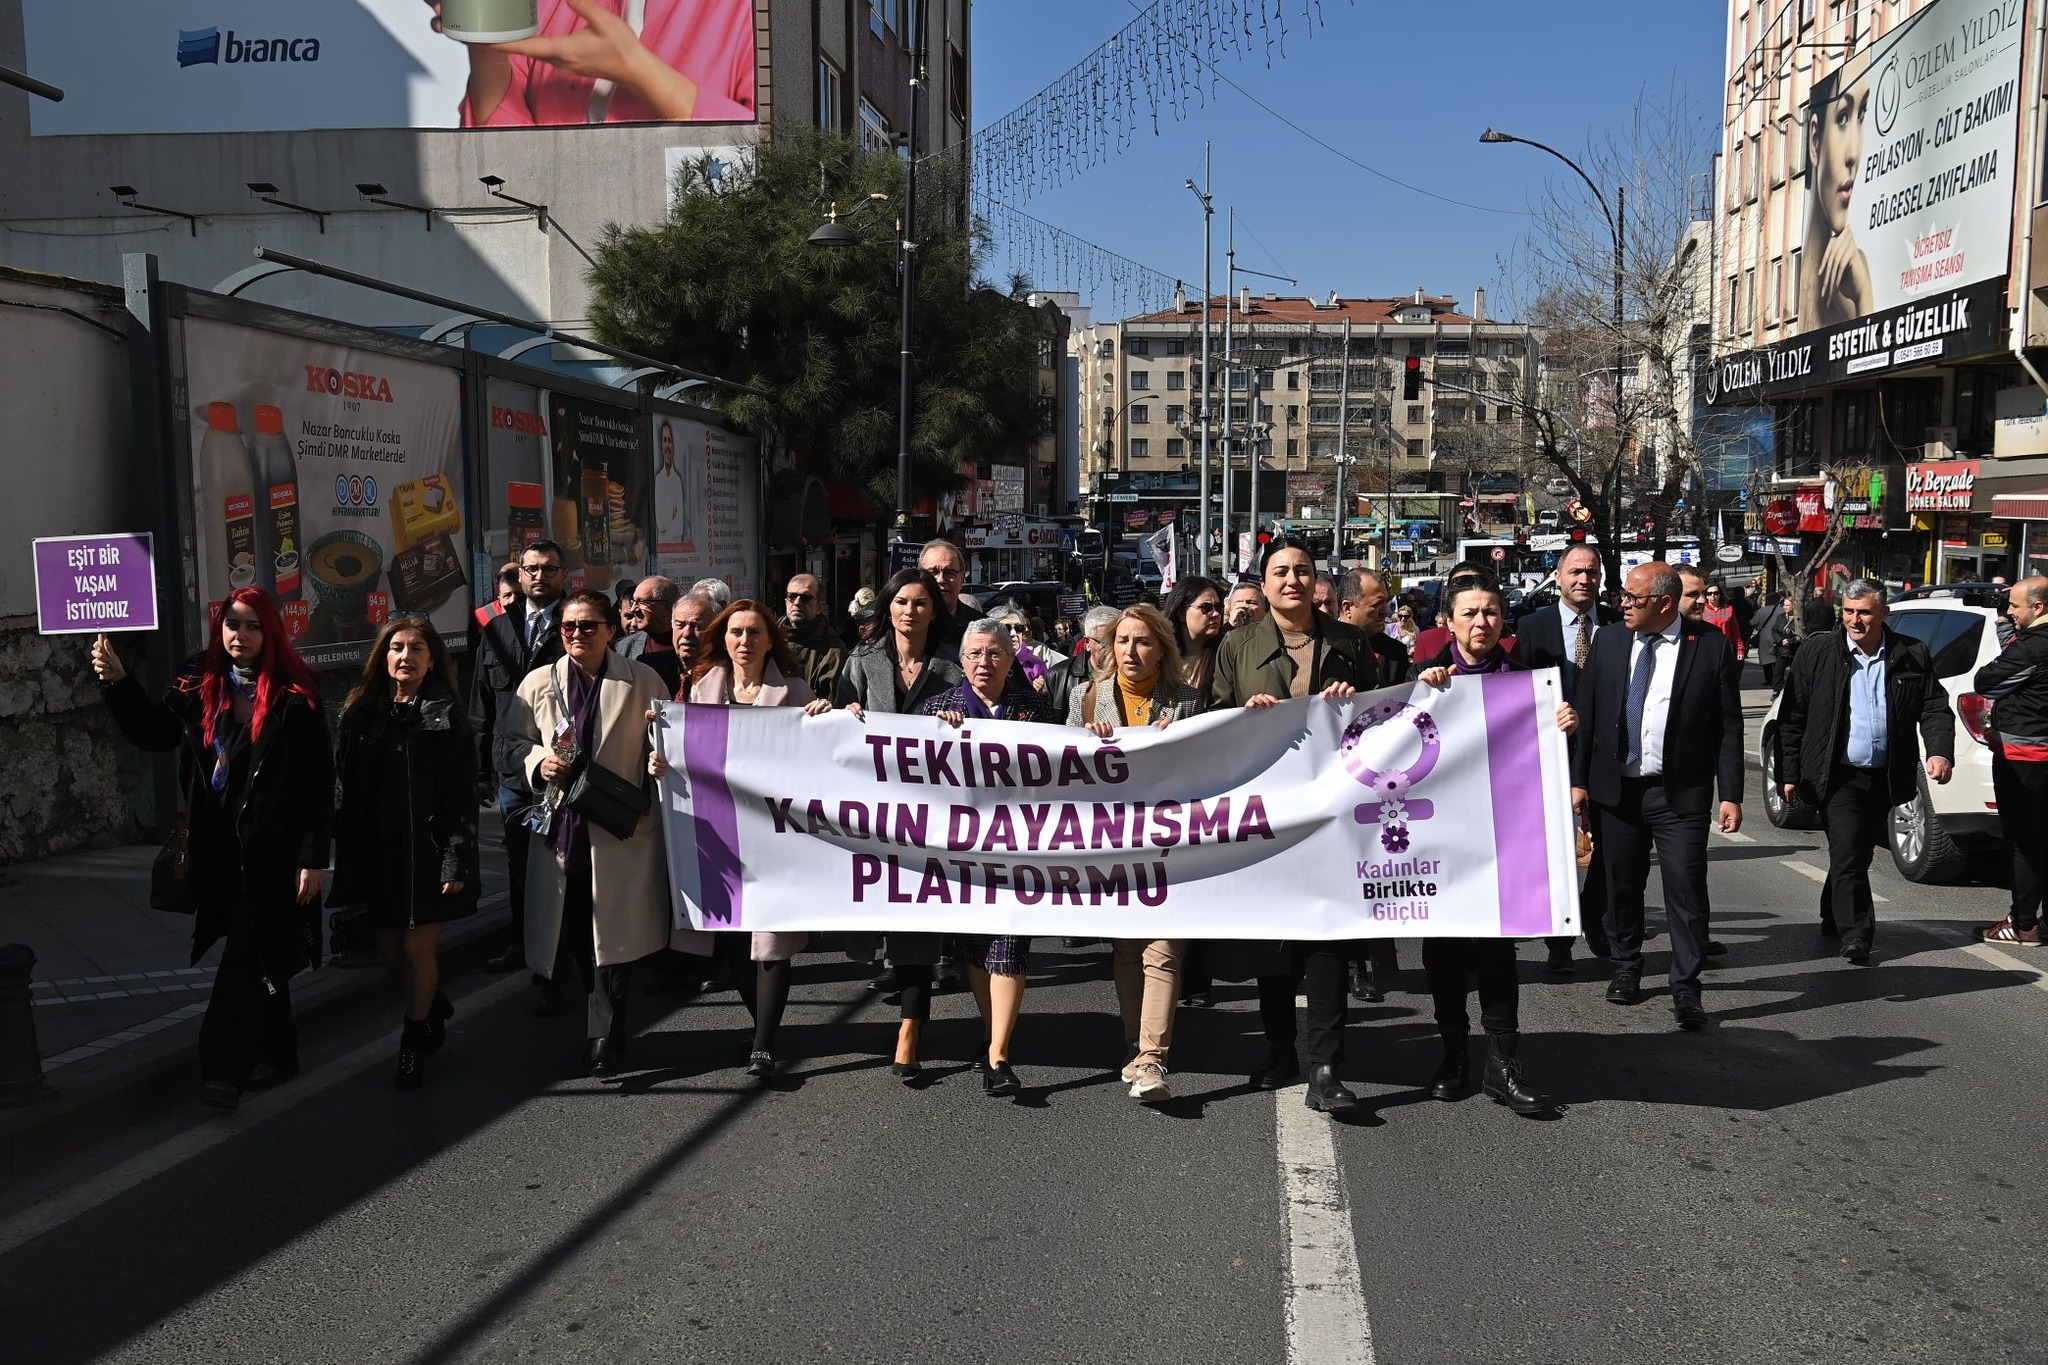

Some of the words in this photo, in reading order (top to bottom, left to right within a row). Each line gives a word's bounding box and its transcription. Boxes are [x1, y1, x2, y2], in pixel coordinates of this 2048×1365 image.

[224, 30, 320, 64] bianca
[1905, 36, 1956, 89] ÖZLEM
[1961, 0, 2018, 55] YILDIZ
[1864, 127, 1925, 184] EPİLASYON
[1934, 106, 1963, 149] CİLT
[1963, 79, 2014, 134] BAKIMI
[1869, 182, 1922, 230] BÖLGESEL
[1925, 149, 1998, 207] ZAYIFLAMA
[1914, 225, 1953, 259] ÜCRETSİZ
[1900, 263, 1933, 290] TANIŞMA
[1935, 252, 1965, 279] SEANSI
[1828, 318, 1880, 361] ESTETİK
[1881, 319, 1892, 348] &
[1895, 293, 1969, 345] GÜZELLİK
[304, 364, 394, 403] KOSKA
[1723, 357, 1761, 393] ÖZLEM
[1768, 345, 1811, 382] YILDIZ
[343, 401, 361, 412] 1907
[302, 420, 331, 437] Nazar
[333, 424, 374, 441] Boncuklu
[376, 428, 401, 445] Koska
[491, 405, 548, 438] KOSKA
[297, 439, 326, 460] Şimdi
[328, 443, 349, 459] DMR
[351, 446, 406, 463] Marketlerde!
[1908, 466, 1922, 493] Öz
[1924, 467, 1974, 496] Beyzade
[1112, 493, 1137, 501] SIEMENS
[1910, 495, 1935, 508] DÖNER
[1938, 495, 1971, 508] SALONU
[68, 544, 95, 571] EŞİT
[99, 543, 120, 566] BİR
[74, 574, 117, 597] YAŞAM
[66, 598, 129, 620] İSTİYORUZ
[284, 604, 307, 617] 144,99
[369, 595, 386, 606] 94,99
[317, 648, 360, 663] BELEDİYESİ
[865, 730, 1129, 788] TEKİRDAĞ
[763, 796, 929, 849] KADIN
[947, 795, 1276, 858] DAYANIŞMA
[852, 852, 1169, 907] PLATFORMU
[1356, 858, 1441, 880] Kadınlar
[1363, 879, 1437, 900] Birlikte
[1372, 901, 1430, 926] Güçlü
